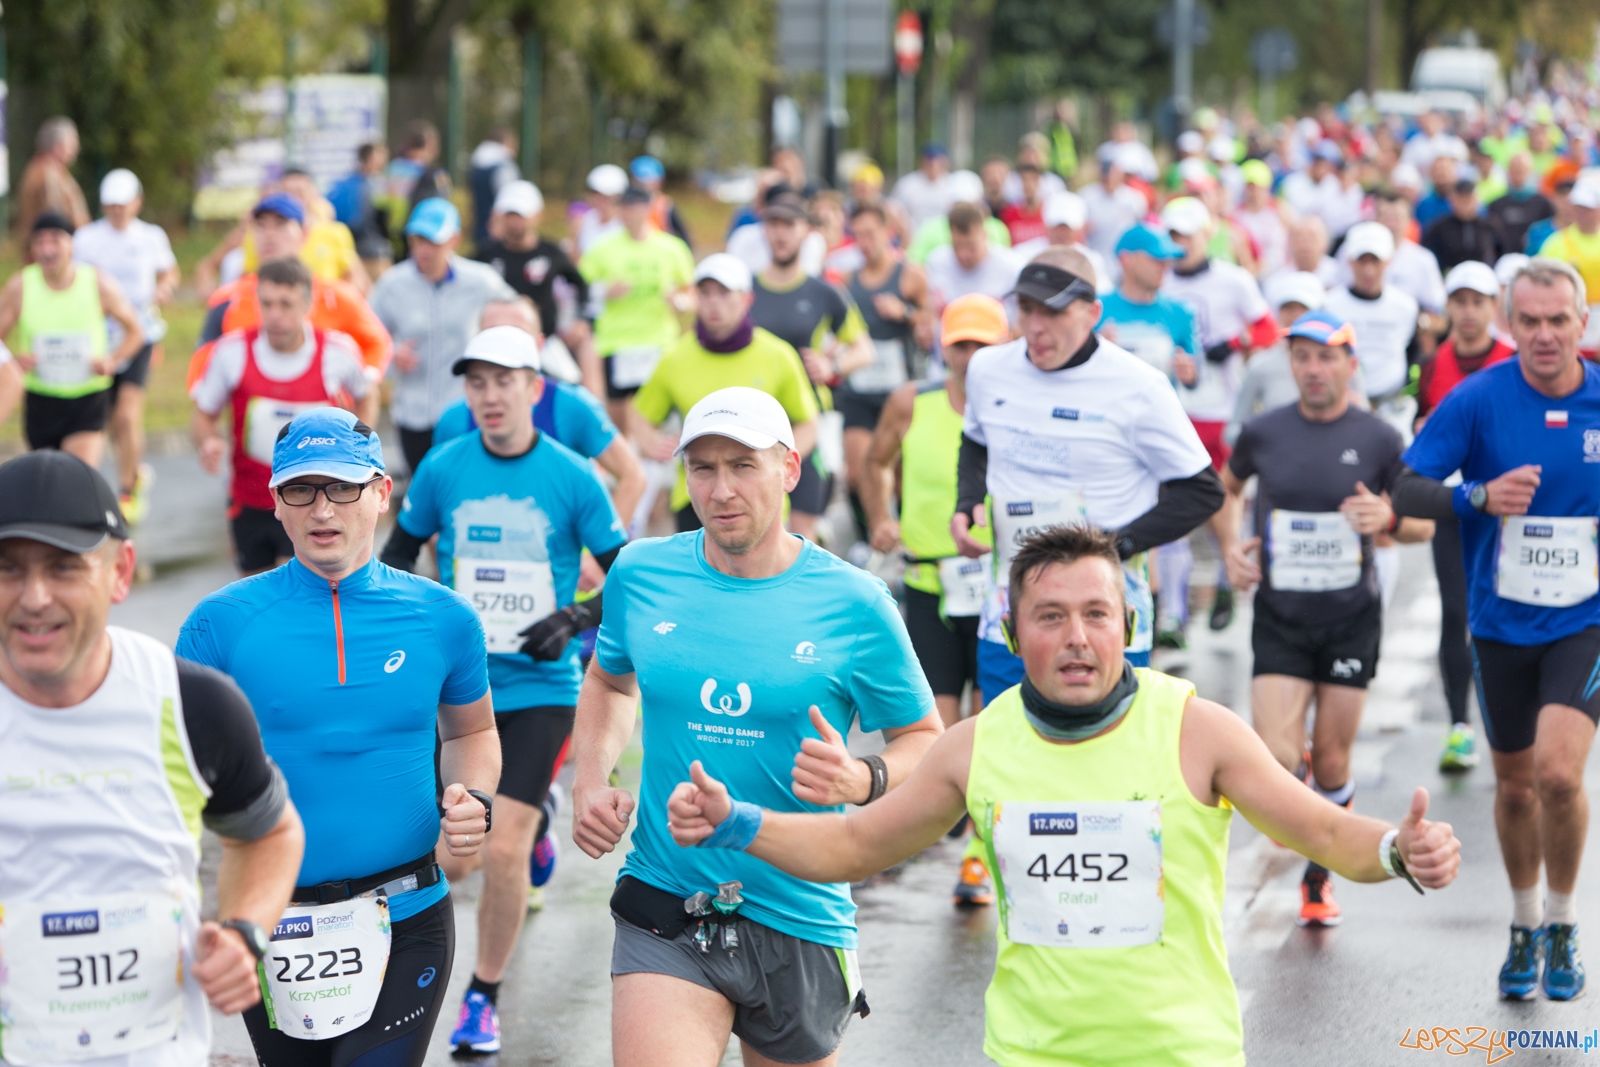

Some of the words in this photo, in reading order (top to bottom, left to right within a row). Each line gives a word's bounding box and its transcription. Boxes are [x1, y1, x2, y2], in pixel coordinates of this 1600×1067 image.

[309, 436, 337, 447] asics
[1519, 546, 1579, 568] 3053
[473, 592, 534, 613] 5780
[687, 721, 702, 731] THE
[704, 724, 734, 735] WORLD
[735, 728, 765, 738] GAMES
[735, 738, 755, 747] 2017
[1027, 853, 1128, 882] 4452
[317, 921, 354, 932] maraton
[58, 948, 139, 989] 3112
[273, 947, 363, 982] 2223
[289, 984, 352, 1002] Krzysztof
